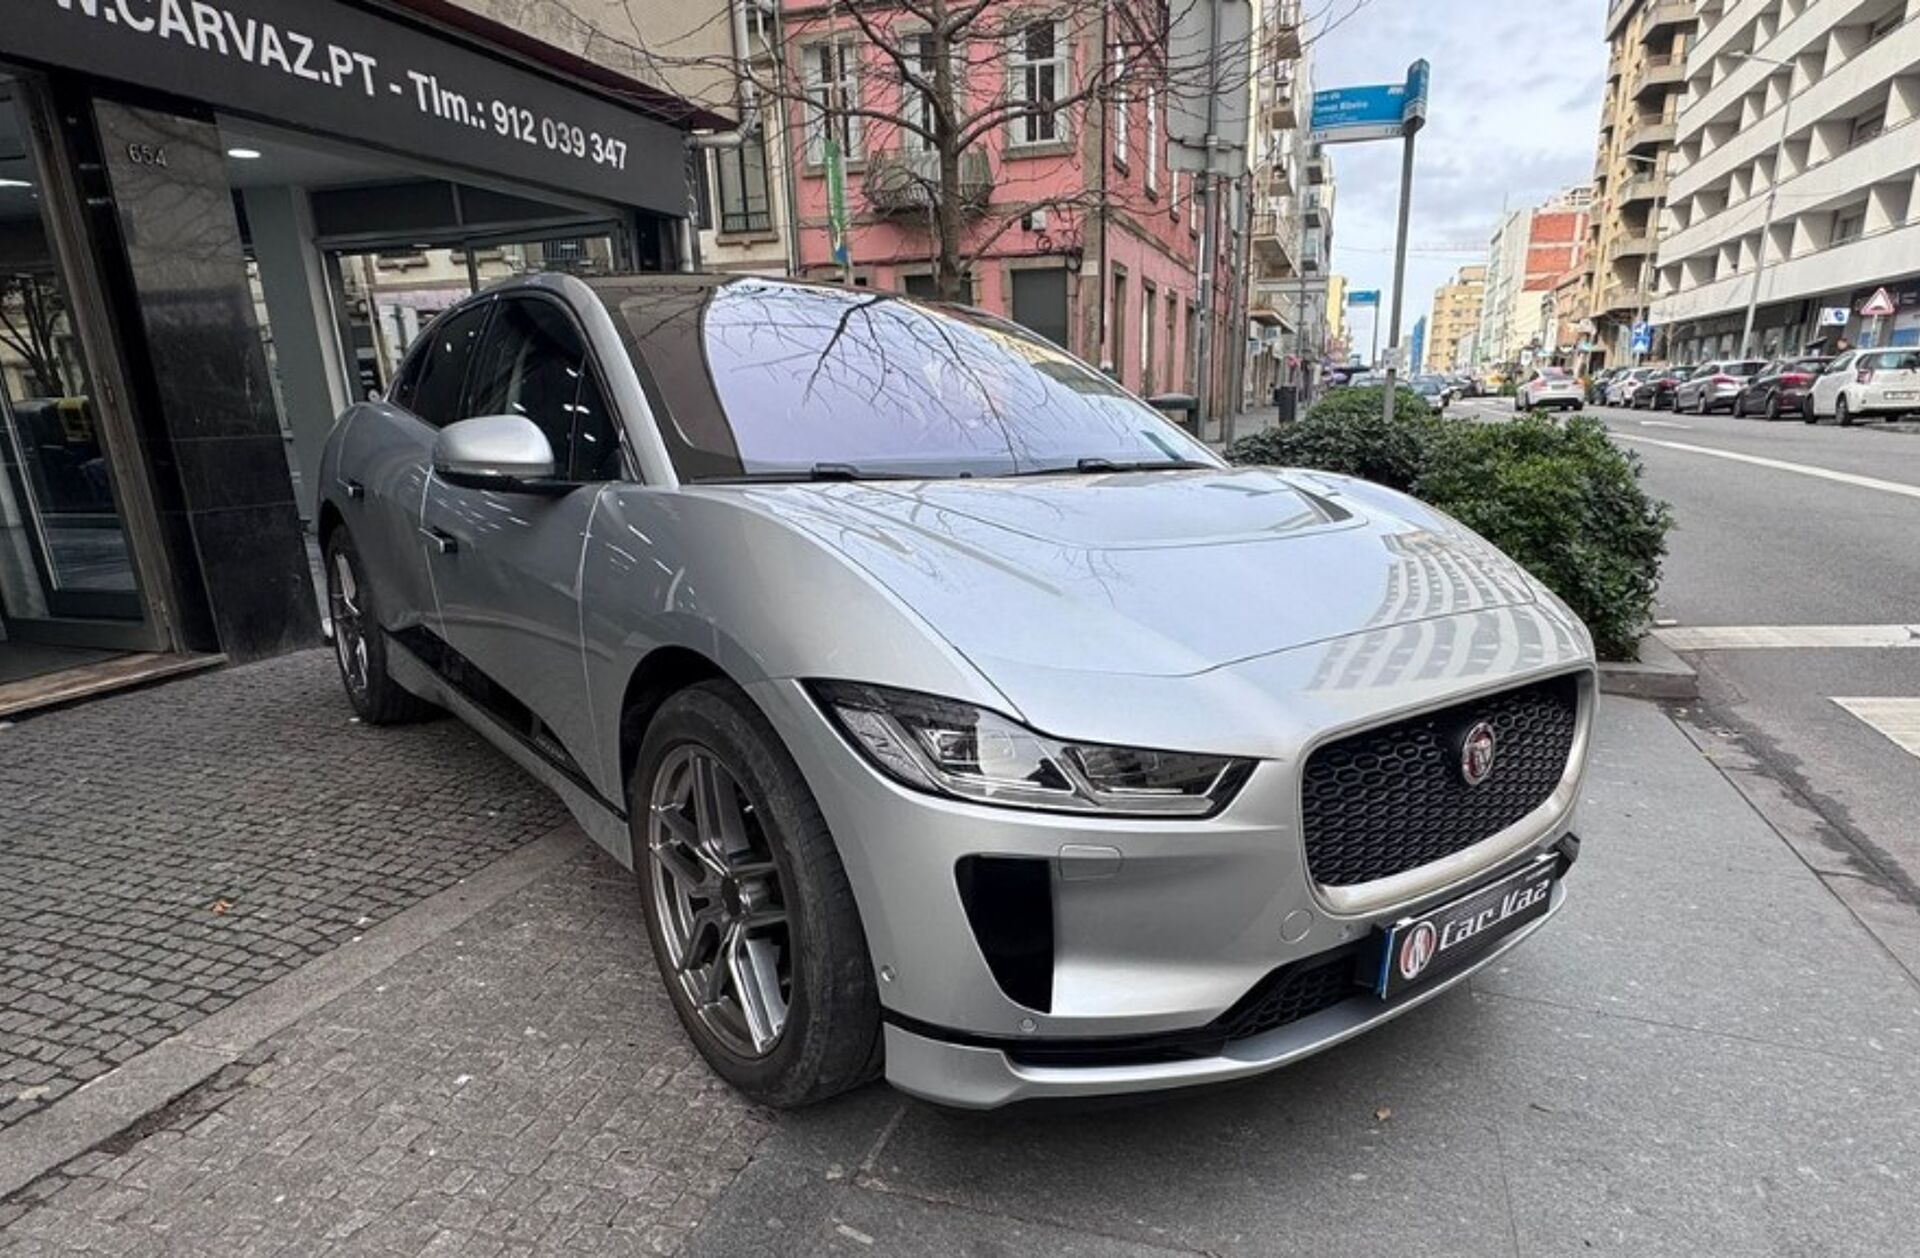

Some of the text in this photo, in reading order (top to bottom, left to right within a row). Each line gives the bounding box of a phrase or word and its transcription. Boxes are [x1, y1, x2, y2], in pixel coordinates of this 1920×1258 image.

[129, 143, 168, 167] 654
[407, 69, 486, 130] Tlm.:
[492, 100, 537, 145] 912
[542, 117, 585, 158] 039
[590, 132, 627, 170] 347
[1439, 879, 1550, 951] Car Vaz
